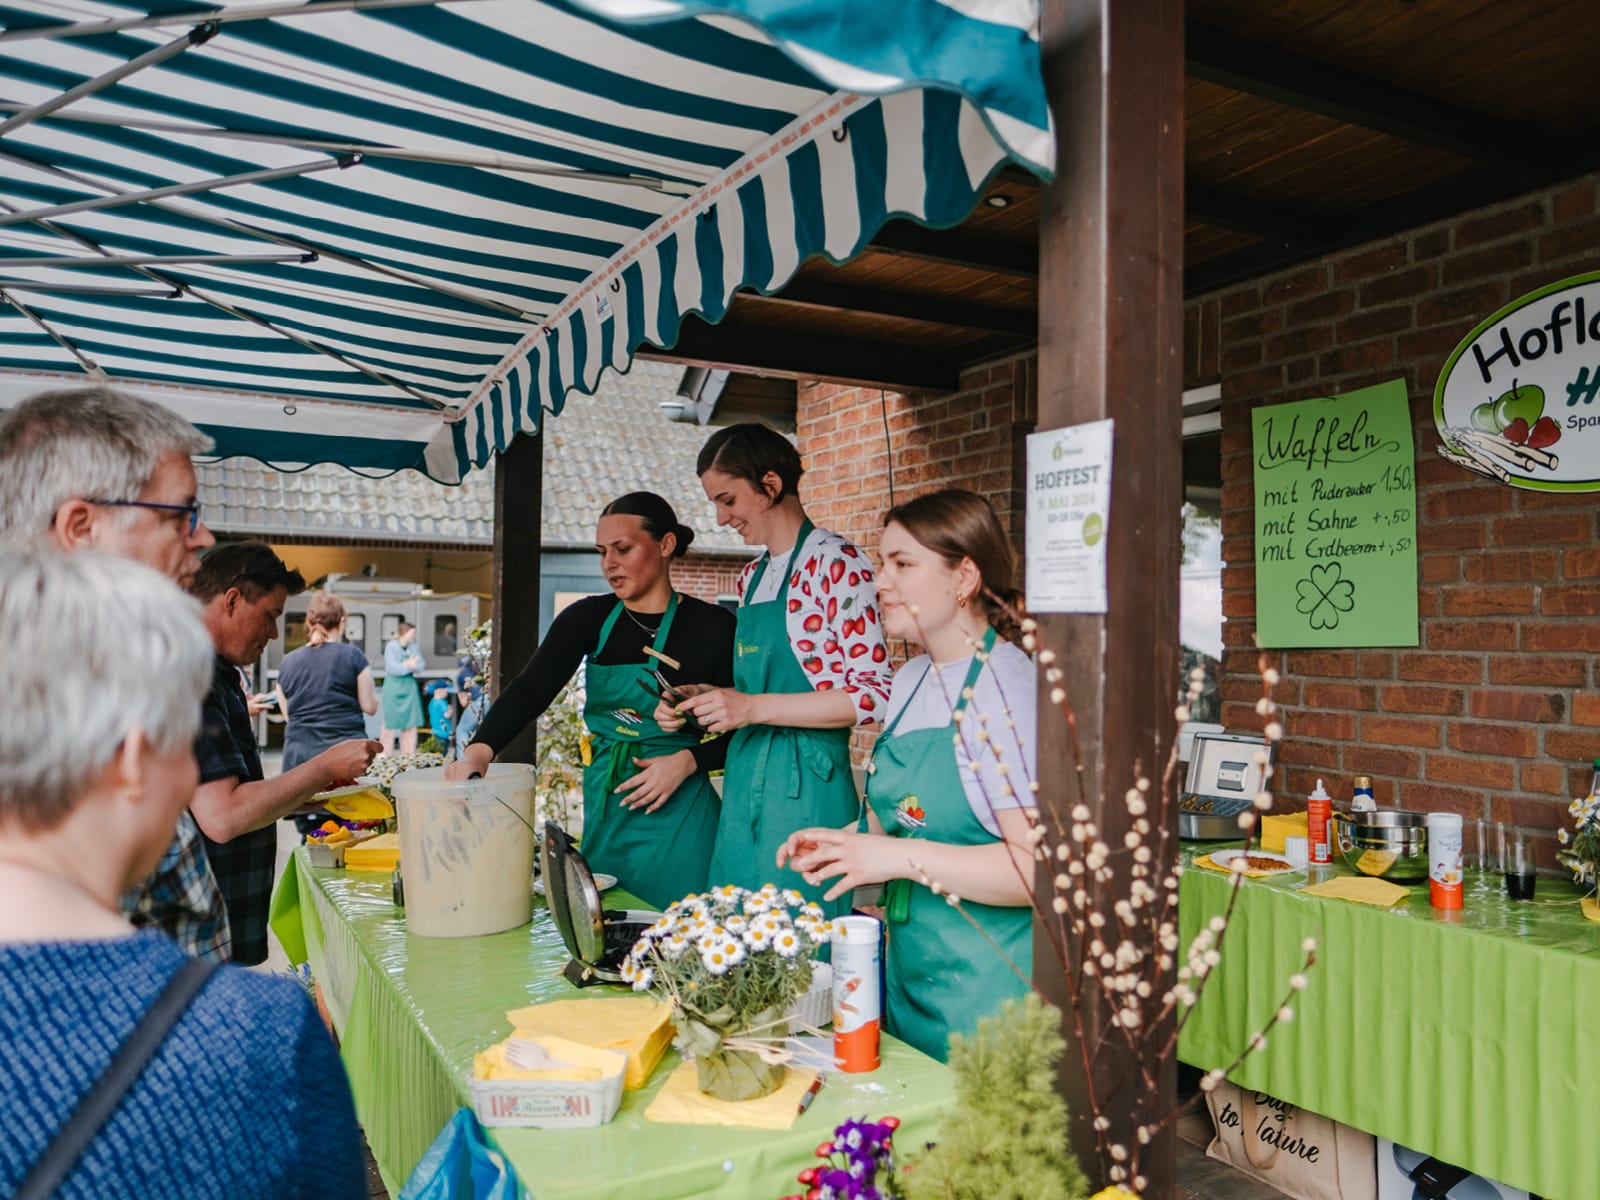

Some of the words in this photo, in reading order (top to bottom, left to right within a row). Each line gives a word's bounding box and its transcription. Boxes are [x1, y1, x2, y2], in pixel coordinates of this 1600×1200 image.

[1261, 410, 1382, 470] Waffeln
[1035, 465, 1101, 491] HOFFEST
[1264, 480, 1298, 507] mit
[1263, 511, 1295, 536] mit
[1306, 508, 1358, 532] Sahne
[1262, 539, 1295, 562] mit
[1220, 1102, 1240, 1128] to
